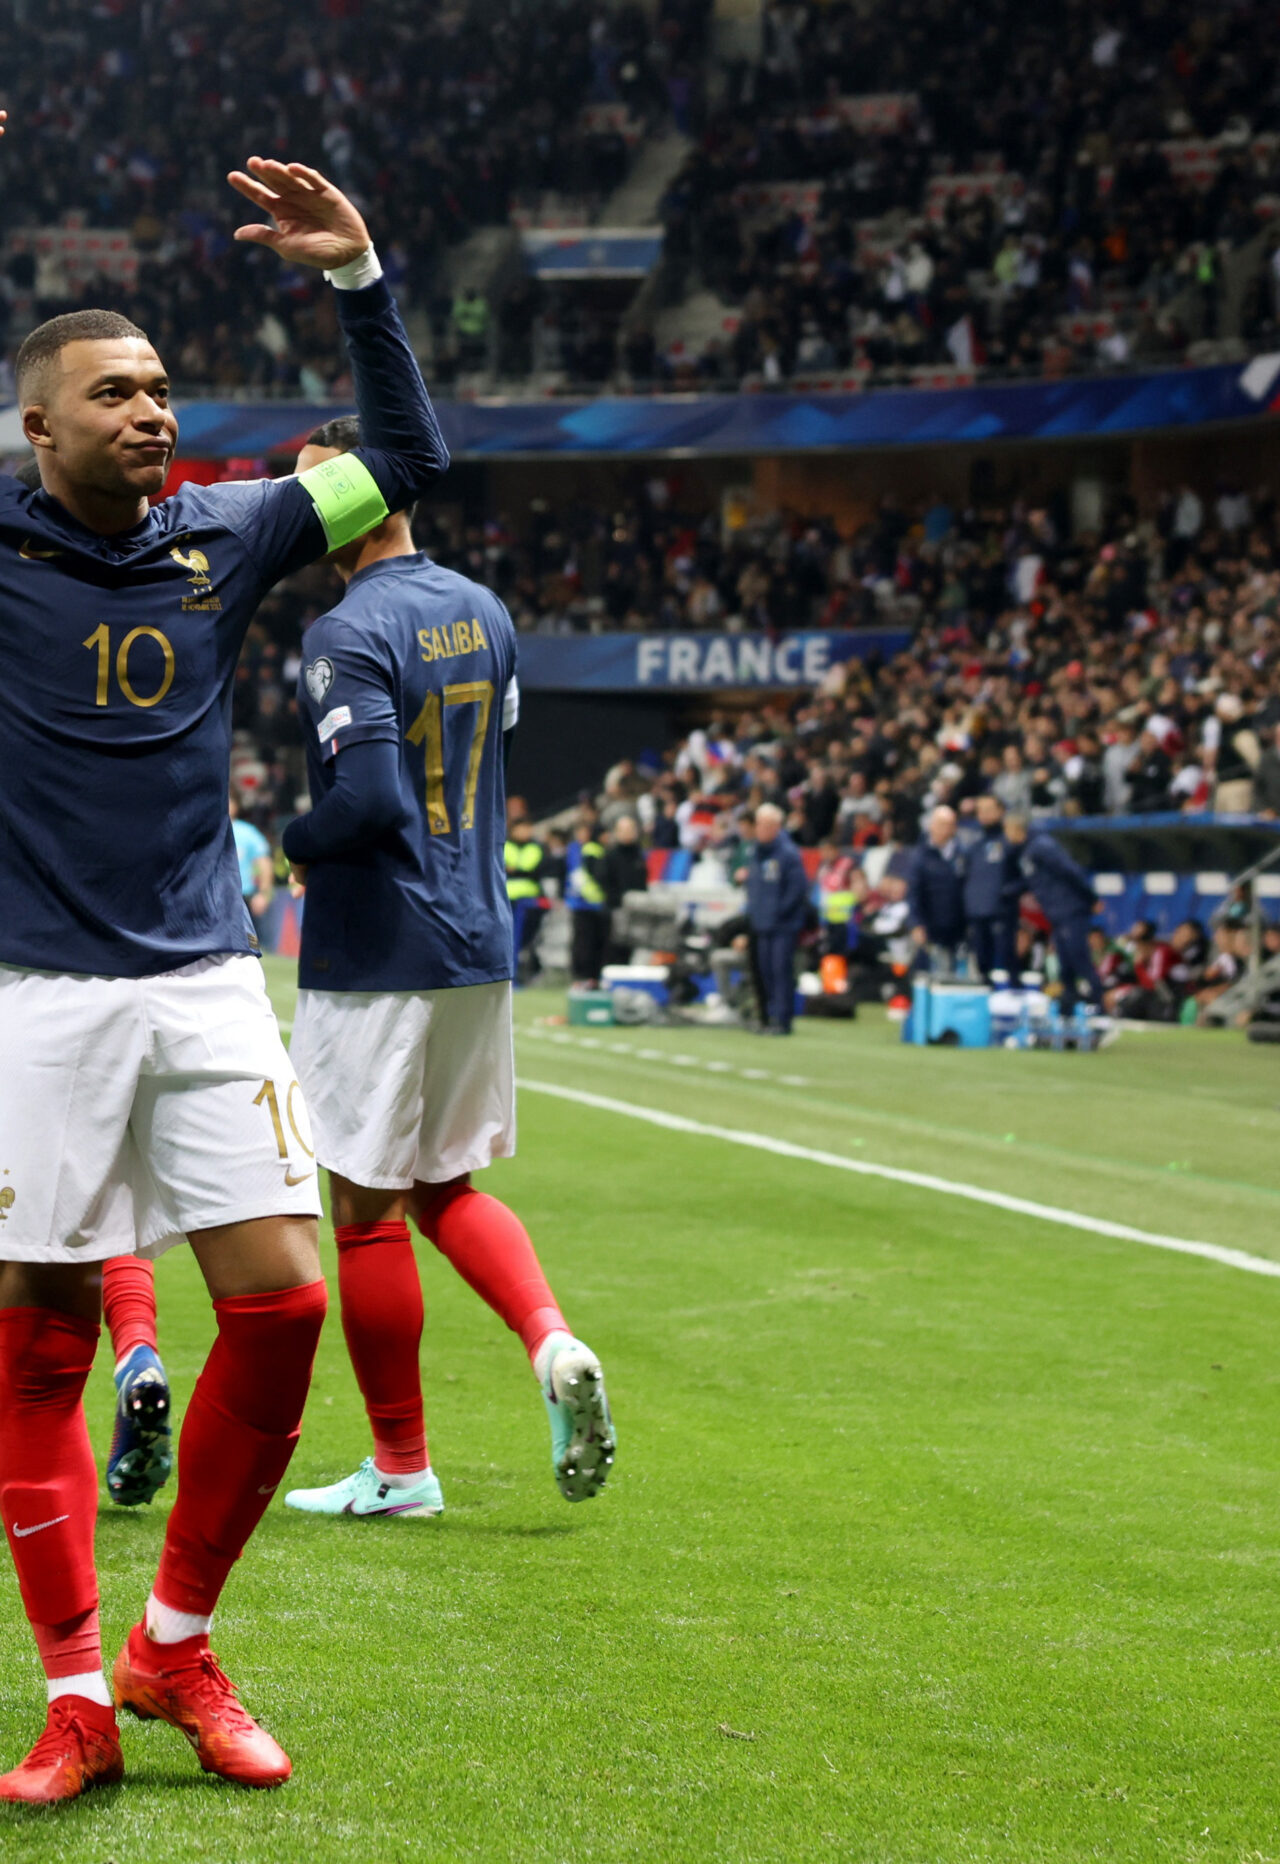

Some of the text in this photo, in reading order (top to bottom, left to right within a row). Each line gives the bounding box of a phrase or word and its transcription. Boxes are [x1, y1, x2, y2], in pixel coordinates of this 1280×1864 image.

[82, 622, 175, 708] 10
[418, 619, 487, 662] SALIBA
[636, 637, 830, 685] FRANCE
[406, 680, 495, 836] 17
